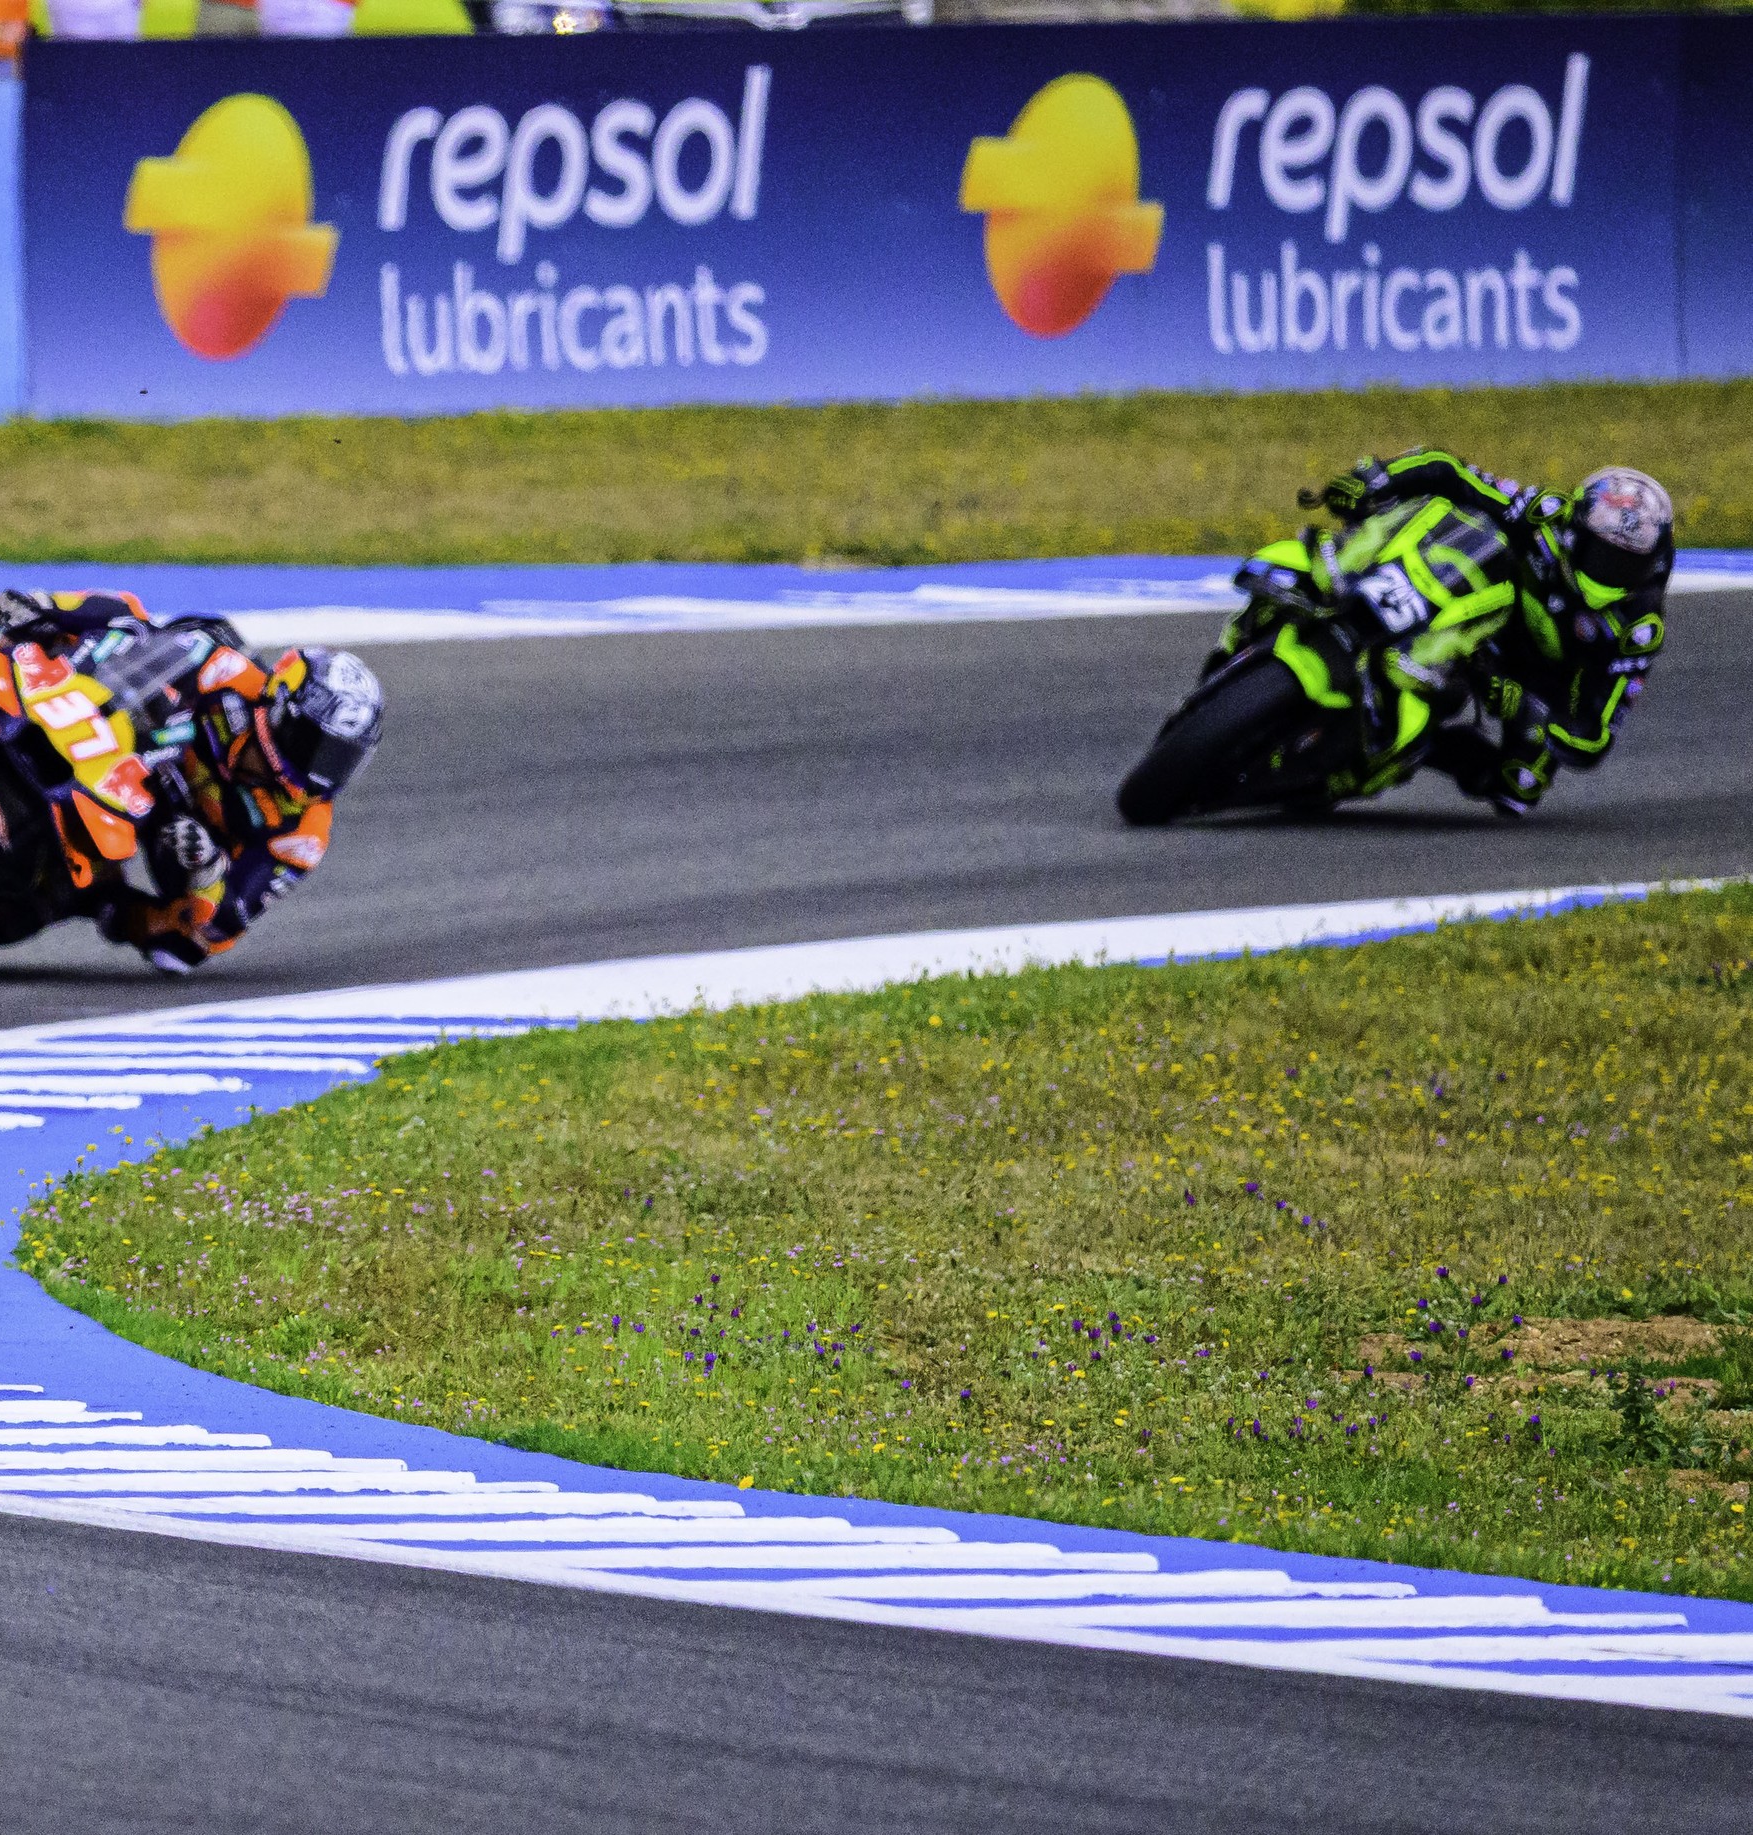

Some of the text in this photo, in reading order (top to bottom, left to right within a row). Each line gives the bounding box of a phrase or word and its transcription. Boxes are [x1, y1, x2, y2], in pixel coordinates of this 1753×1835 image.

[377, 63, 773, 265] repsol
[1206, 51, 1591, 244] repsol
[378, 260, 770, 377] lubricants
[1206, 239, 1582, 355] lubricants
[32, 689, 119, 761] 37
